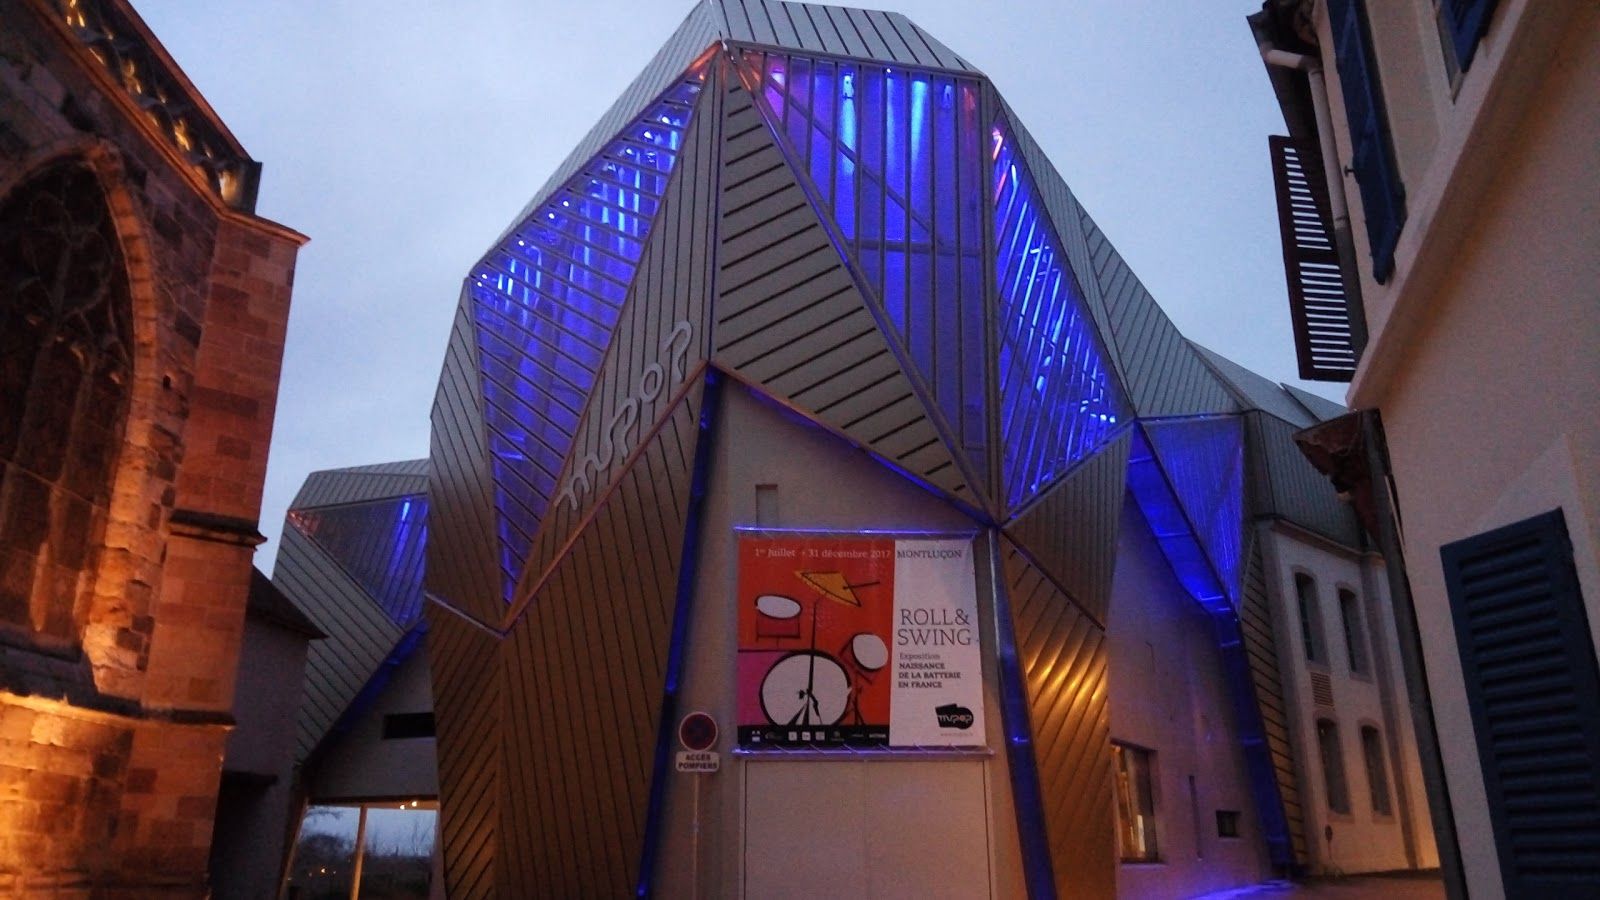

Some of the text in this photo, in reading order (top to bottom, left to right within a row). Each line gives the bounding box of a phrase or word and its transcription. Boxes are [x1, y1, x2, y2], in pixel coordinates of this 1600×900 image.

[807, 548, 819, 557] 31
[821, 548, 867, 559] décembre
[870, 549, 891, 559] 2017
[897, 549, 961, 560] MONTLUÇON
[897, 628, 972, 646] SWING
[899, 653, 941, 662] Exposition
[899, 662, 945, 670] NAISSANCE
